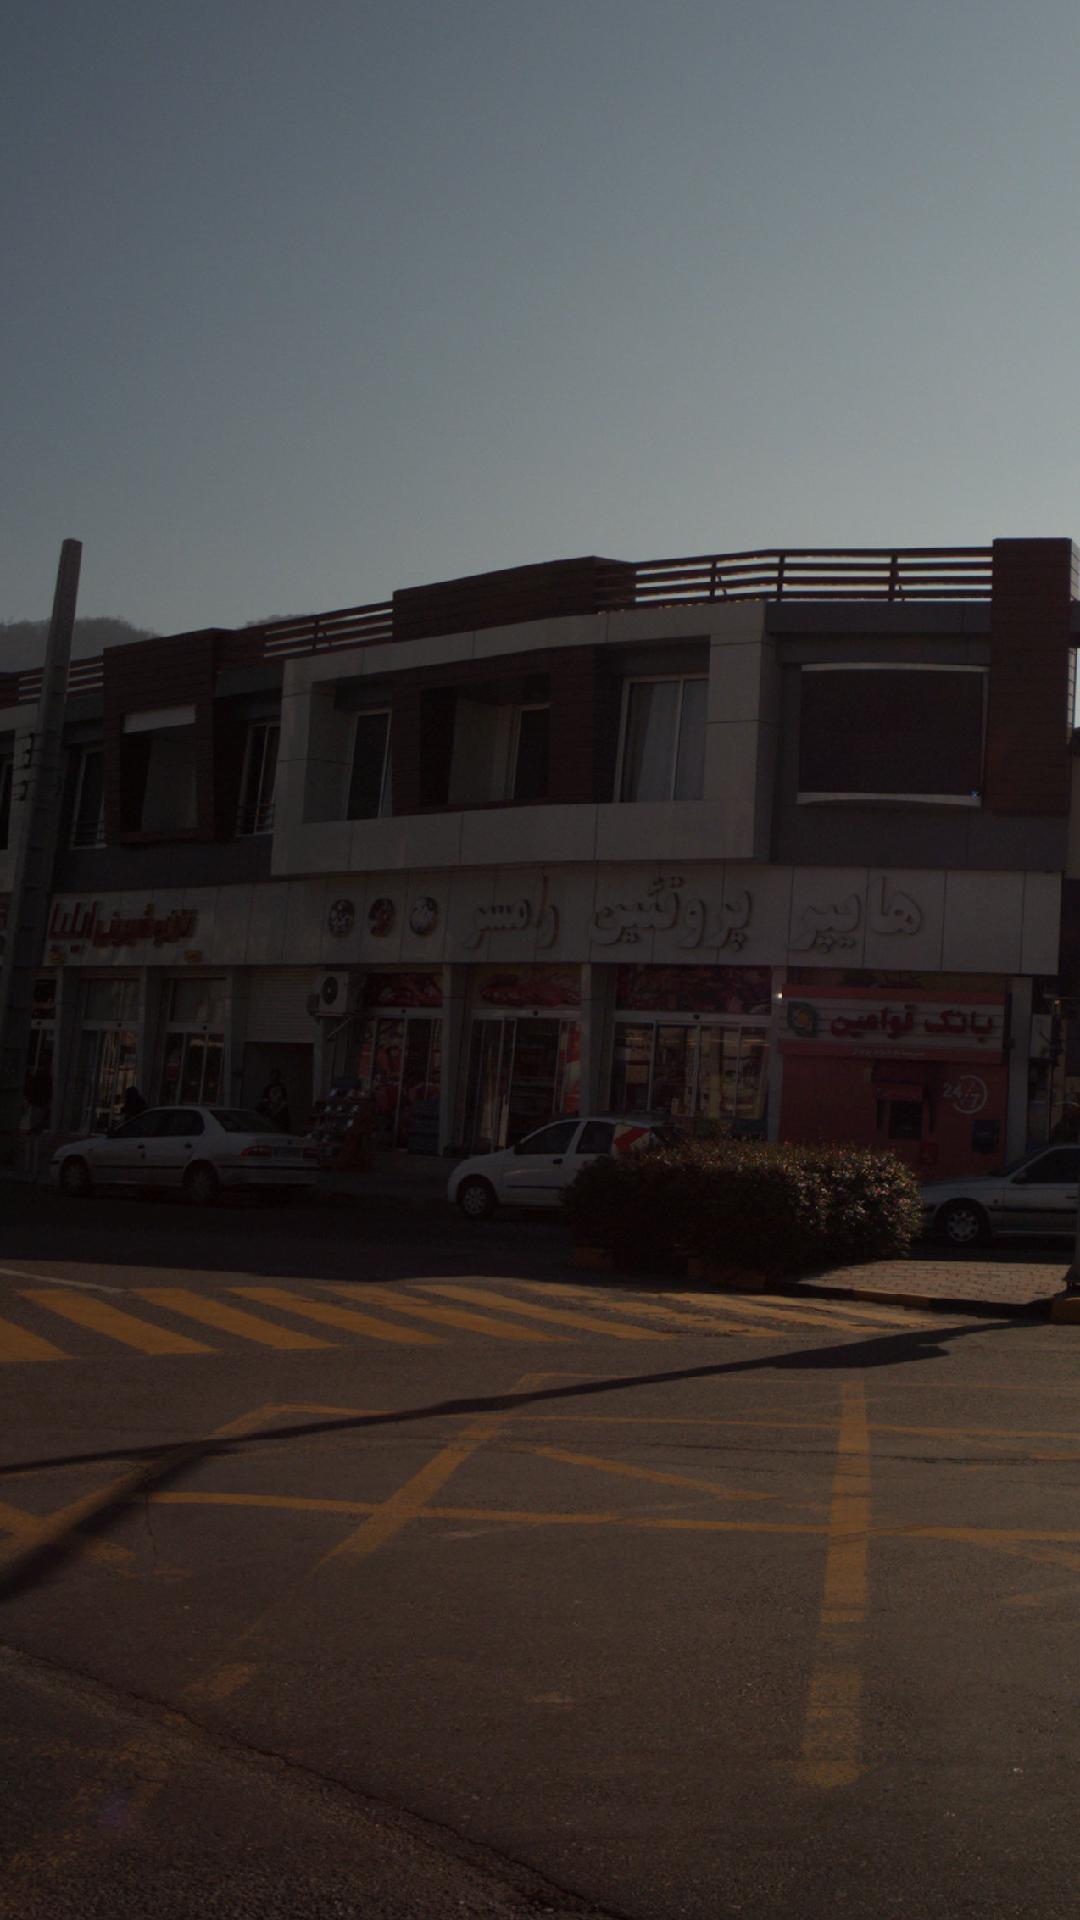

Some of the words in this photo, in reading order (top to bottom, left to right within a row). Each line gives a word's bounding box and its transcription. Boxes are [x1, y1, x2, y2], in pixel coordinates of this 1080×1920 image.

[592, 876, 752, 953] پروتئین
[788, 876, 924, 954] هایپر
[830, 1004, 916, 1040] قوامین
[924, 1008, 994, 1044] بانک
